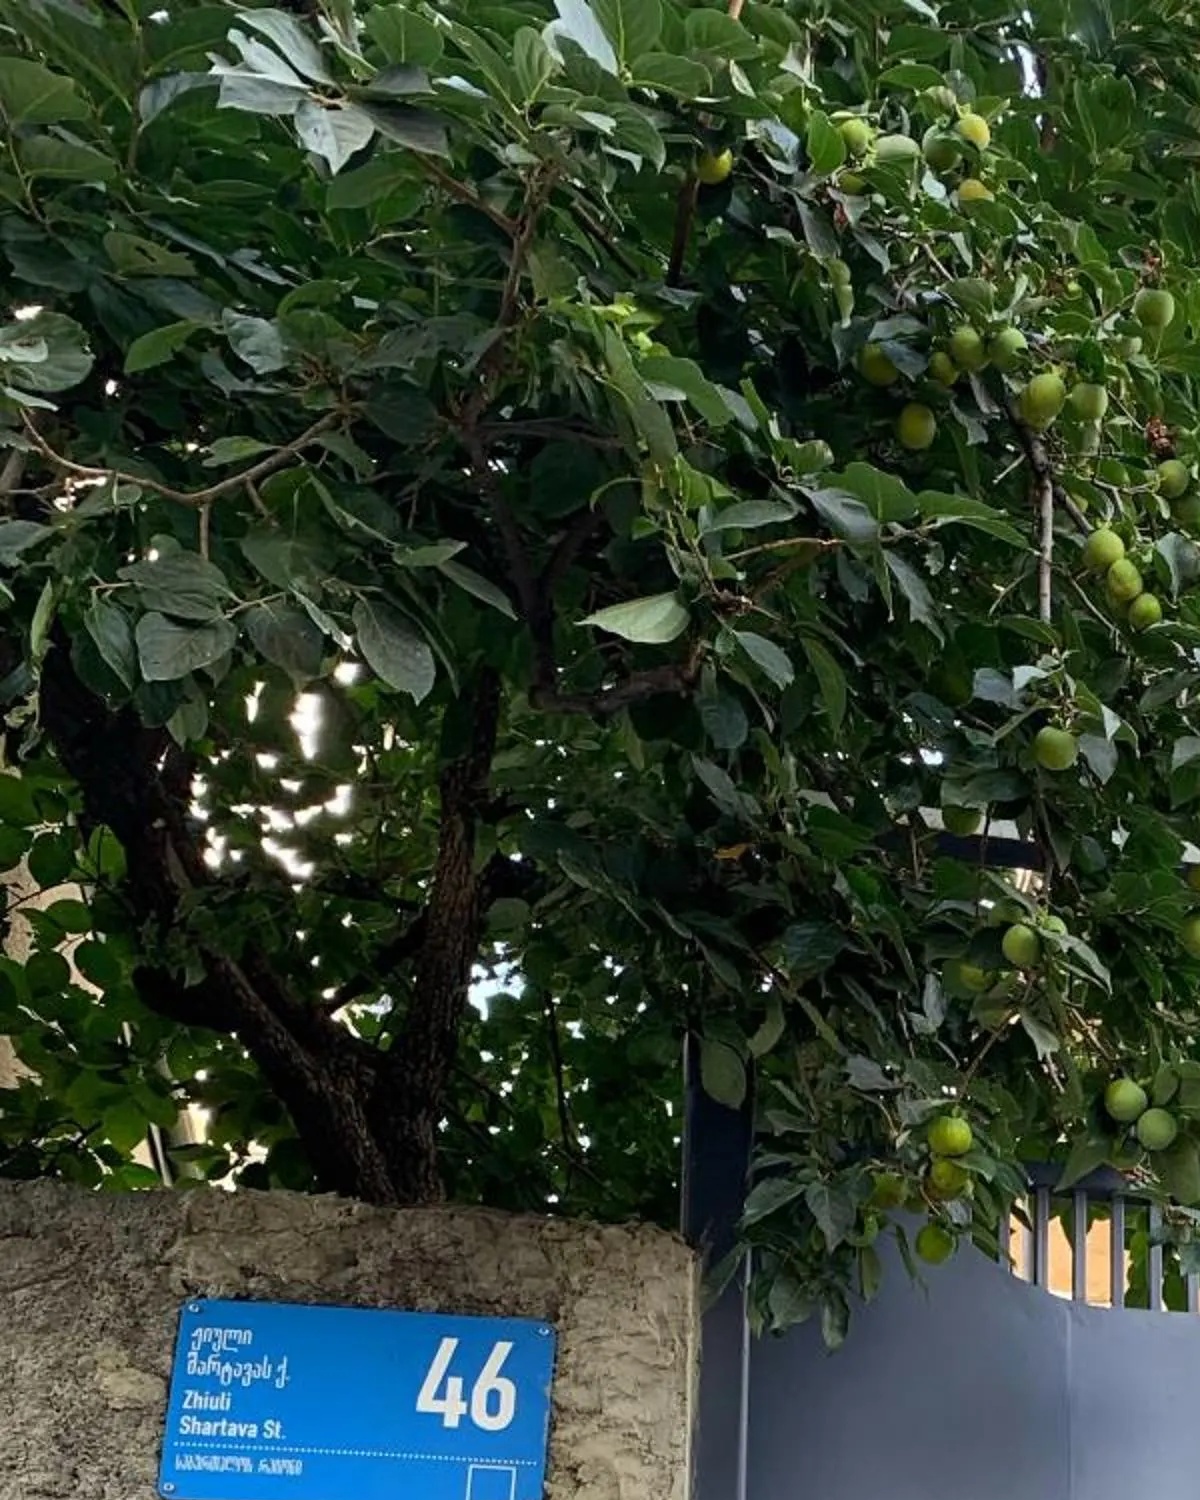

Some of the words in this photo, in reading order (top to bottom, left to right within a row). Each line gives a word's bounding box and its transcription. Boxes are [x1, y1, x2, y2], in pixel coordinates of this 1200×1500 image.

[191, 1327, 253, 1353] ჟიული
[187, 1351, 272, 1386] შარტავას
[416, 1337, 517, 1431] 46
[182, 1389, 232, 1411] Zhiuli
[179, 1415, 258, 1438] Shartava
[263, 1419, 287, 1439] St.
